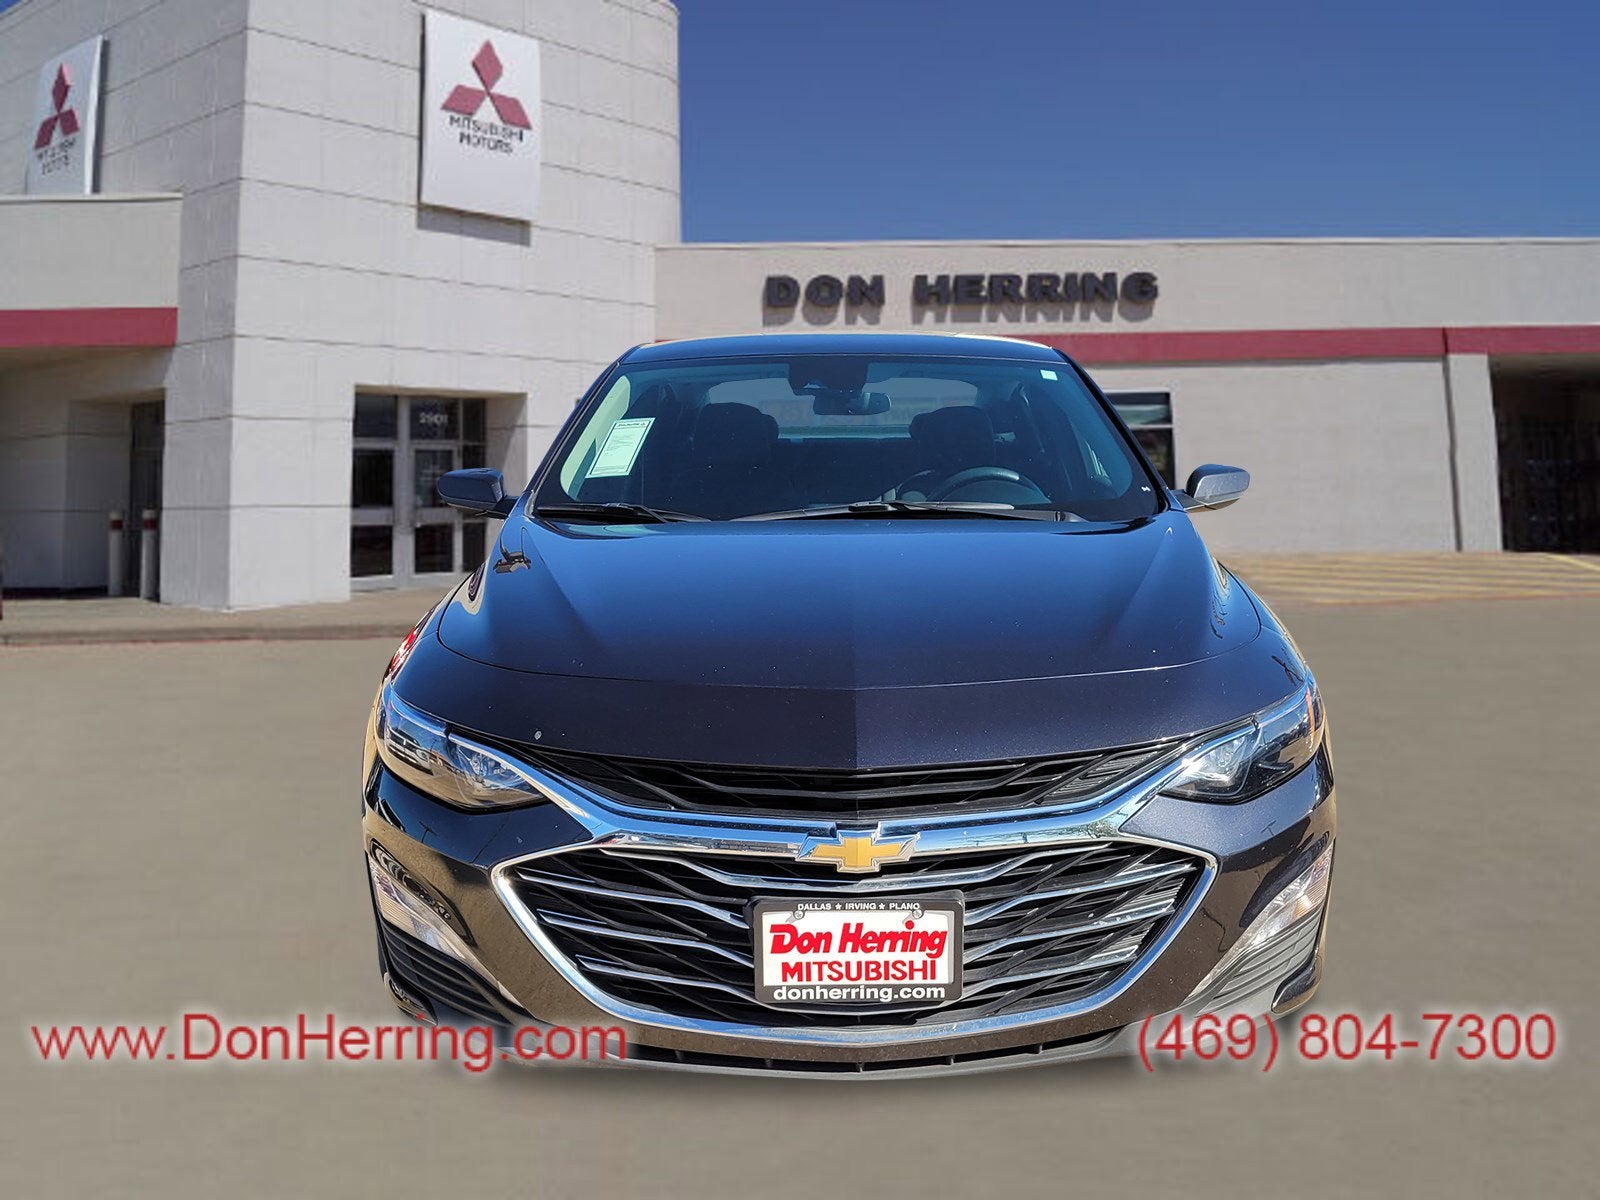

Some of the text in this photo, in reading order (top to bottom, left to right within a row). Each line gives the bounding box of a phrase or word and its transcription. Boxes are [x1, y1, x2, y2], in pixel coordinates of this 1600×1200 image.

[459, 132, 513, 154] MOTORS
[765, 272, 1159, 305] DON HERRING
[797, 902, 920, 911] DALLAS IRVING PLANO
[769, 920, 949, 959] Don Herring
[781, 960, 936, 982] MITSUBISHI
[773, 985, 945, 1002] donherring.com
